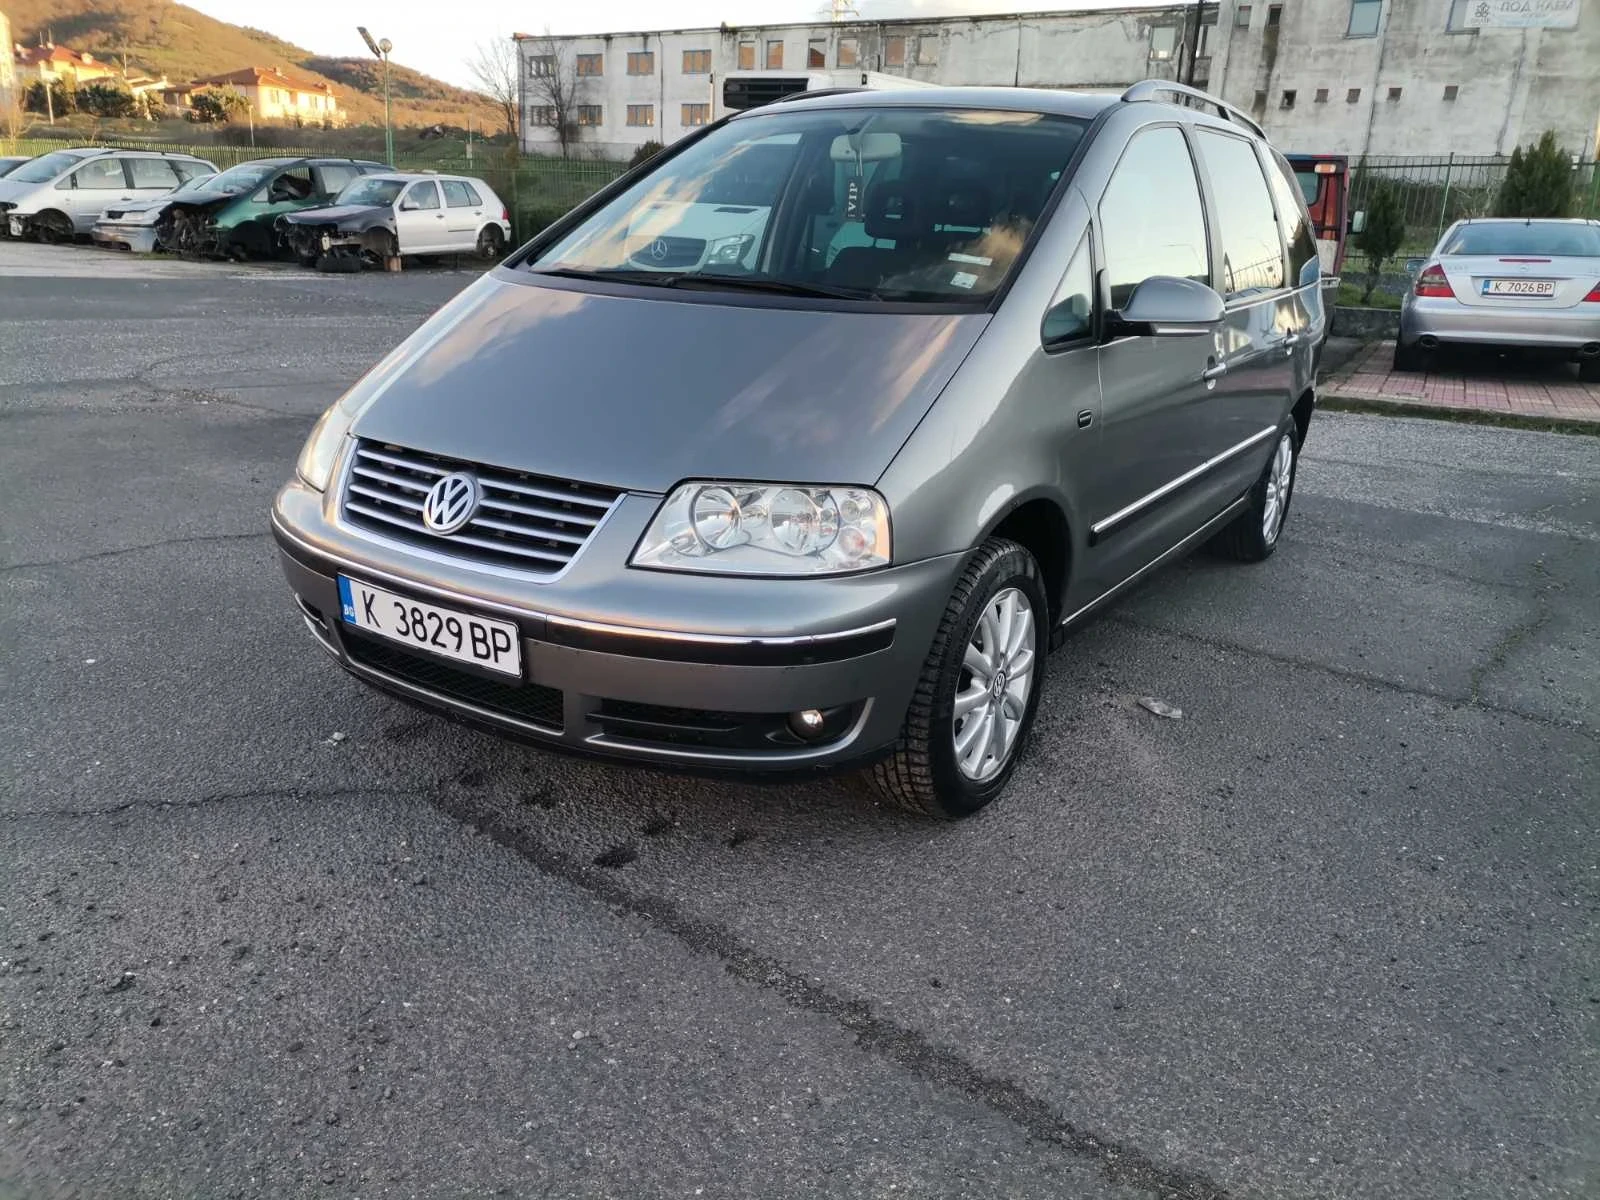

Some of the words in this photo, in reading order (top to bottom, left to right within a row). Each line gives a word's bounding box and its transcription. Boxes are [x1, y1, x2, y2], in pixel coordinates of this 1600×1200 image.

[848, 182, 858, 211] VIP
[1494, 282, 1503, 291] K
[1508, 282, 1534, 292] 7026
[424, 473, 475, 533] VW
[343, 605, 355, 617] BG
[362, 590, 381, 629] K
